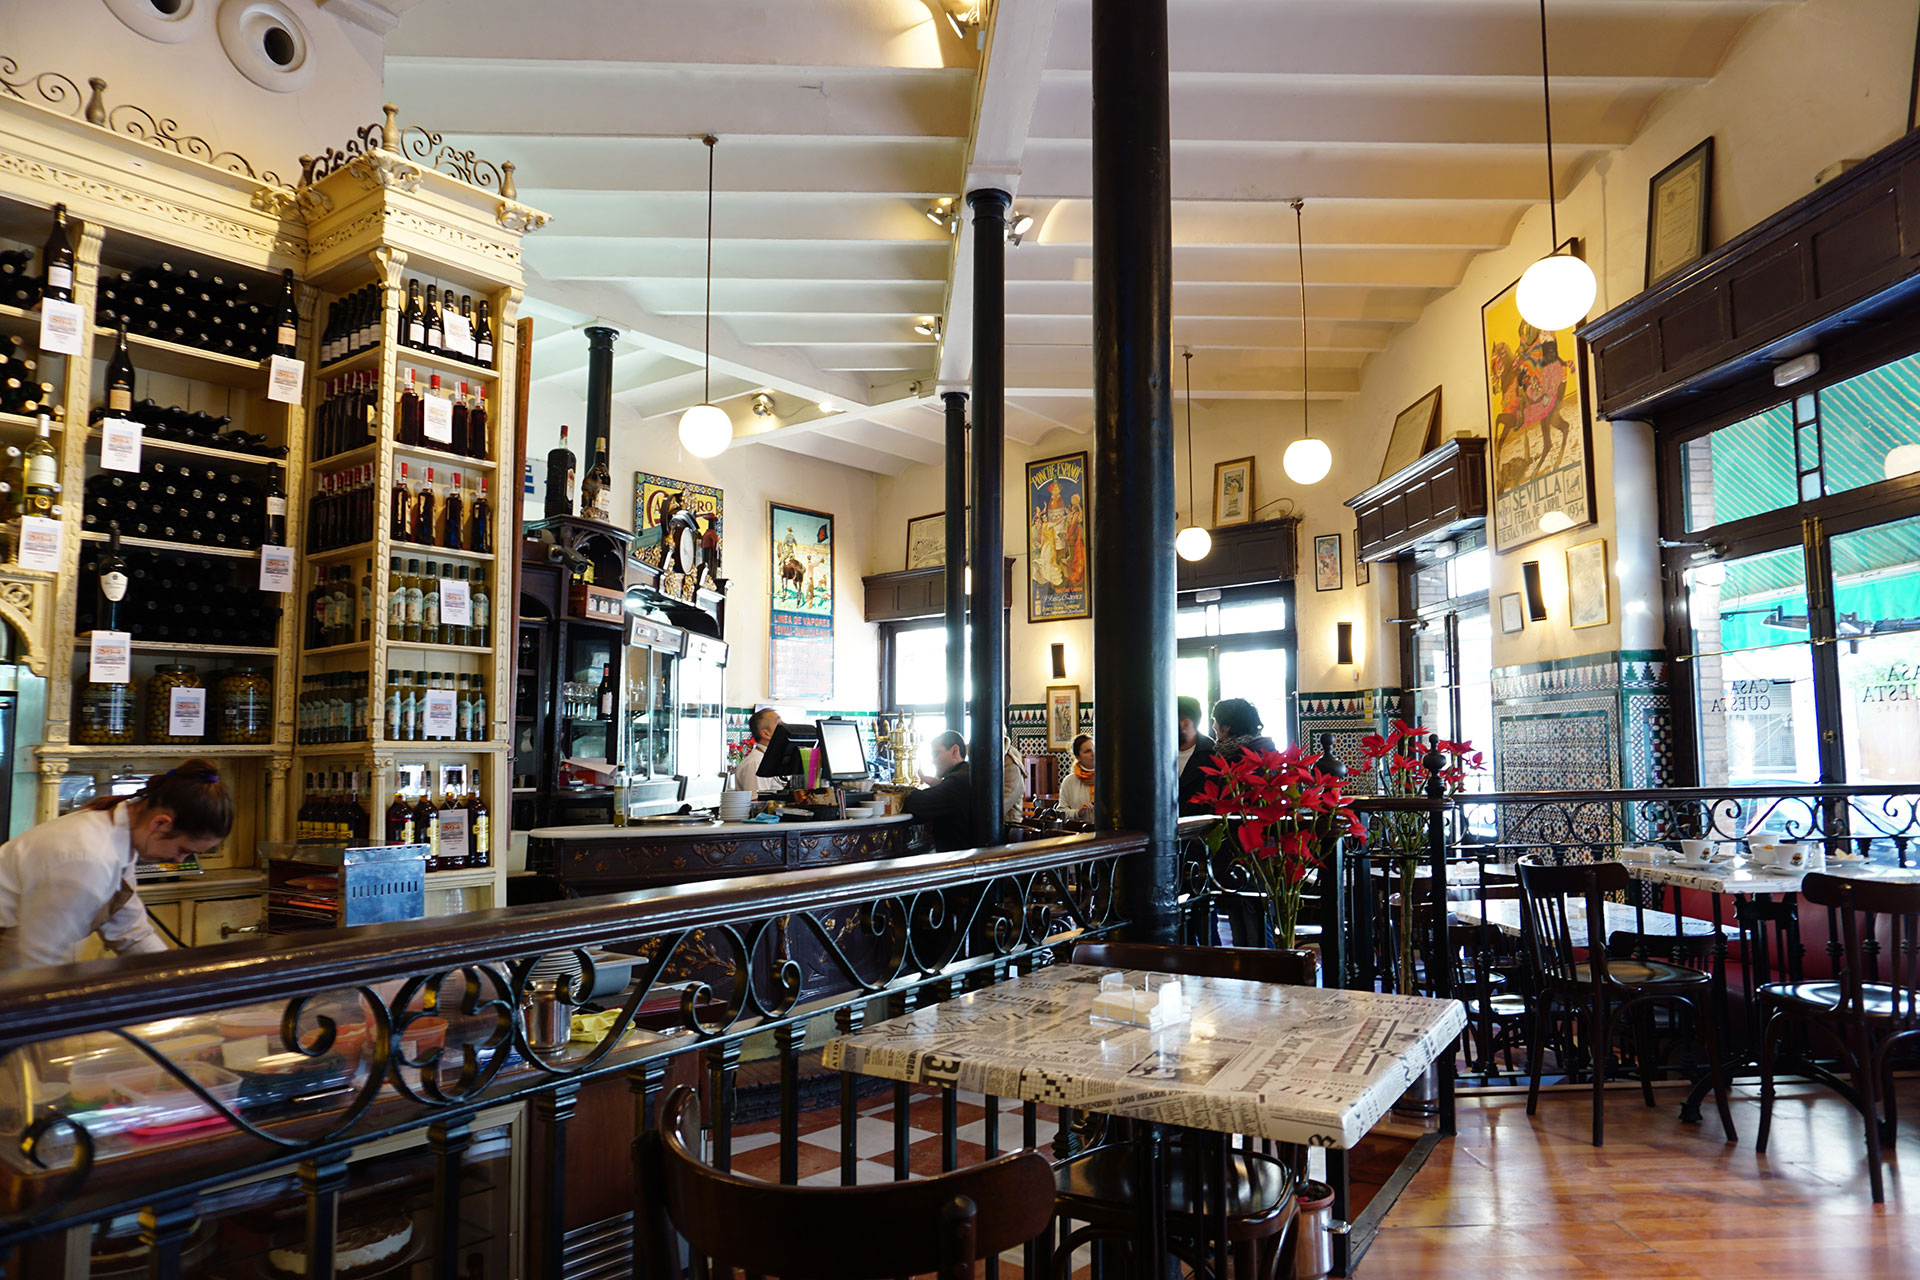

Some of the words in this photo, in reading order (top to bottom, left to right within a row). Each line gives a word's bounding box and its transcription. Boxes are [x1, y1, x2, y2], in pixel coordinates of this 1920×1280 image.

[1513, 474, 1561, 511] SEVILLA
[1514, 508, 1530, 525] FERIA
[1532, 503, 1540, 518] DE
[1544, 496, 1562, 513] ABRIL
[1567, 503, 1584, 520] 1934
[1499, 526, 1519, 544] FIESTAS
[793, 616, 802, 625] DE
[803, 617, 831, 628] VAPORES
[1136, 1090, 1167, 1101] SHARE
